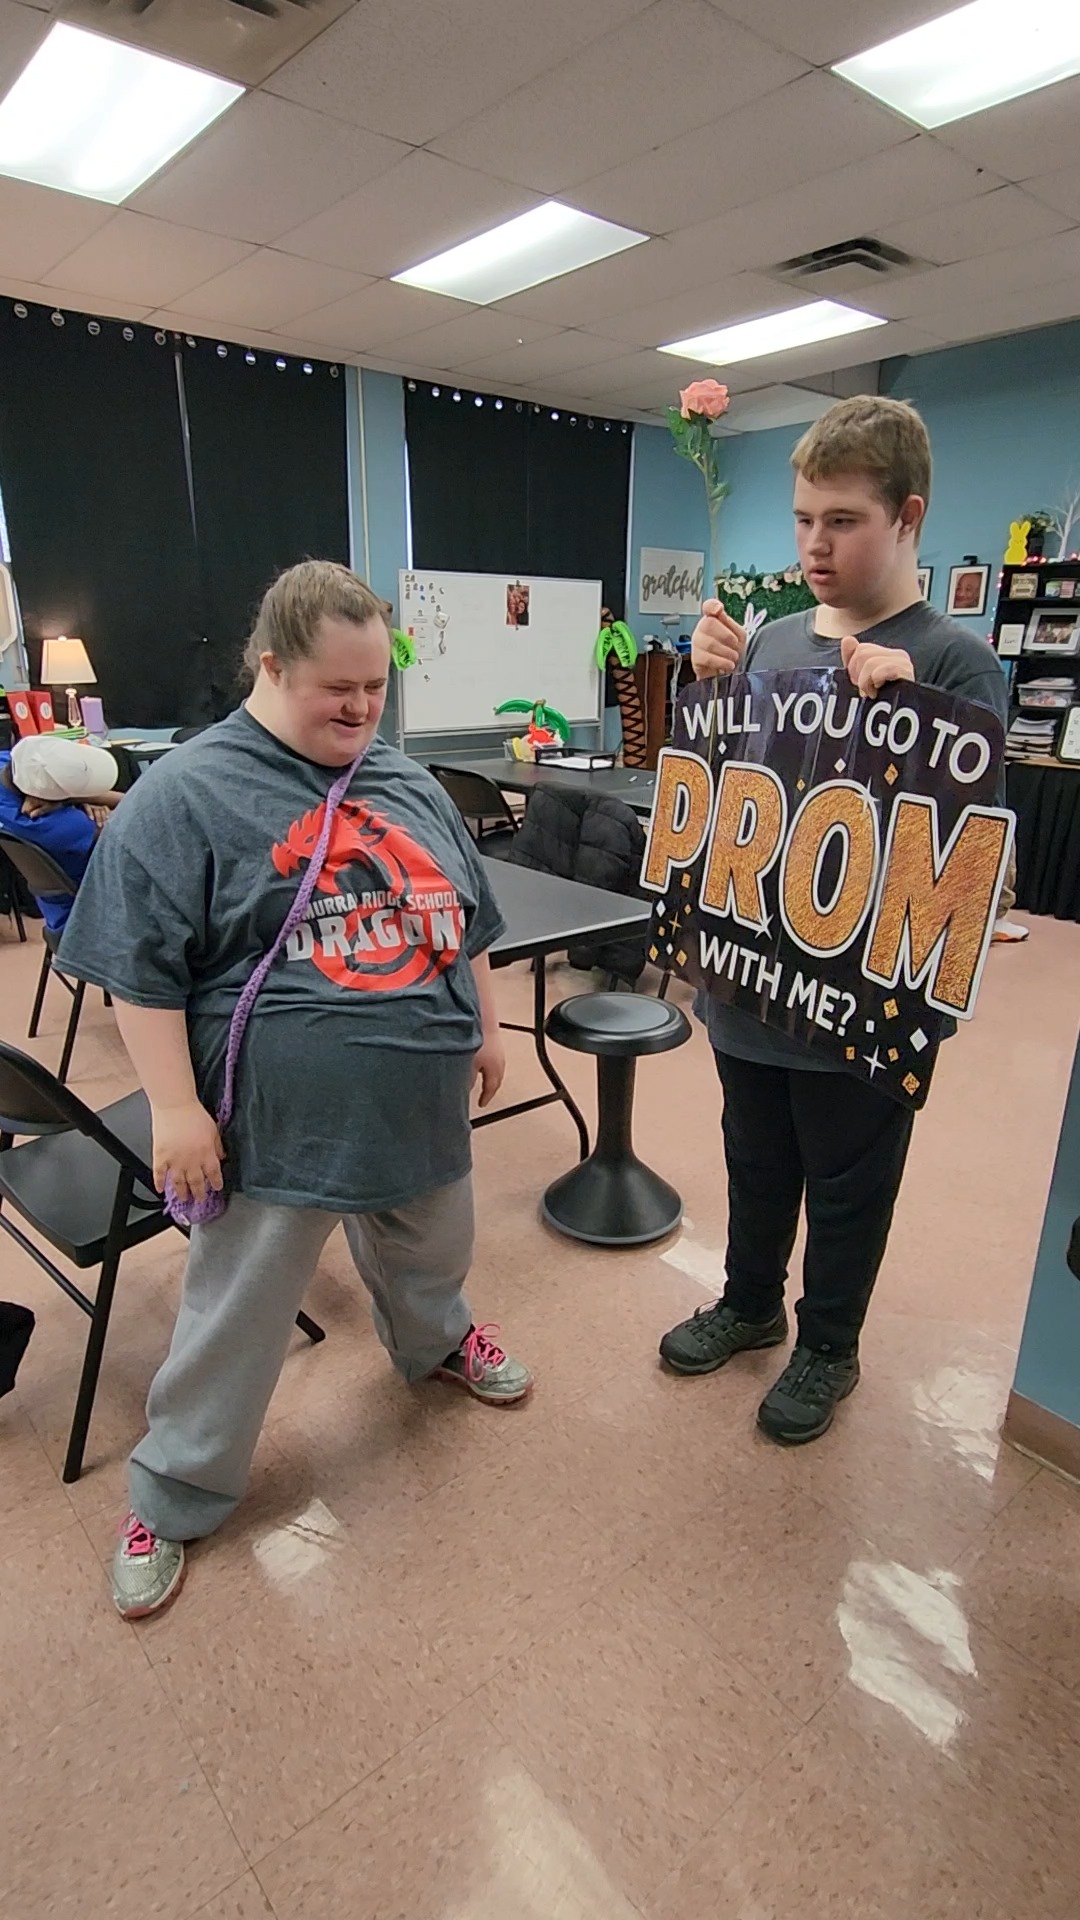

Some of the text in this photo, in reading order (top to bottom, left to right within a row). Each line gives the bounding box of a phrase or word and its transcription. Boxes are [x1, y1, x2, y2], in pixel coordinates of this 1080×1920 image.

[642, 565, 704, 601] grateful
[682, 692, 991, 784] WILL YOU GO TO
[405, 891, 461, 911] SCHOOL
[638, 747, 1016, 1021] PROM
[700, 930, 857, 1037] WITH ME?
